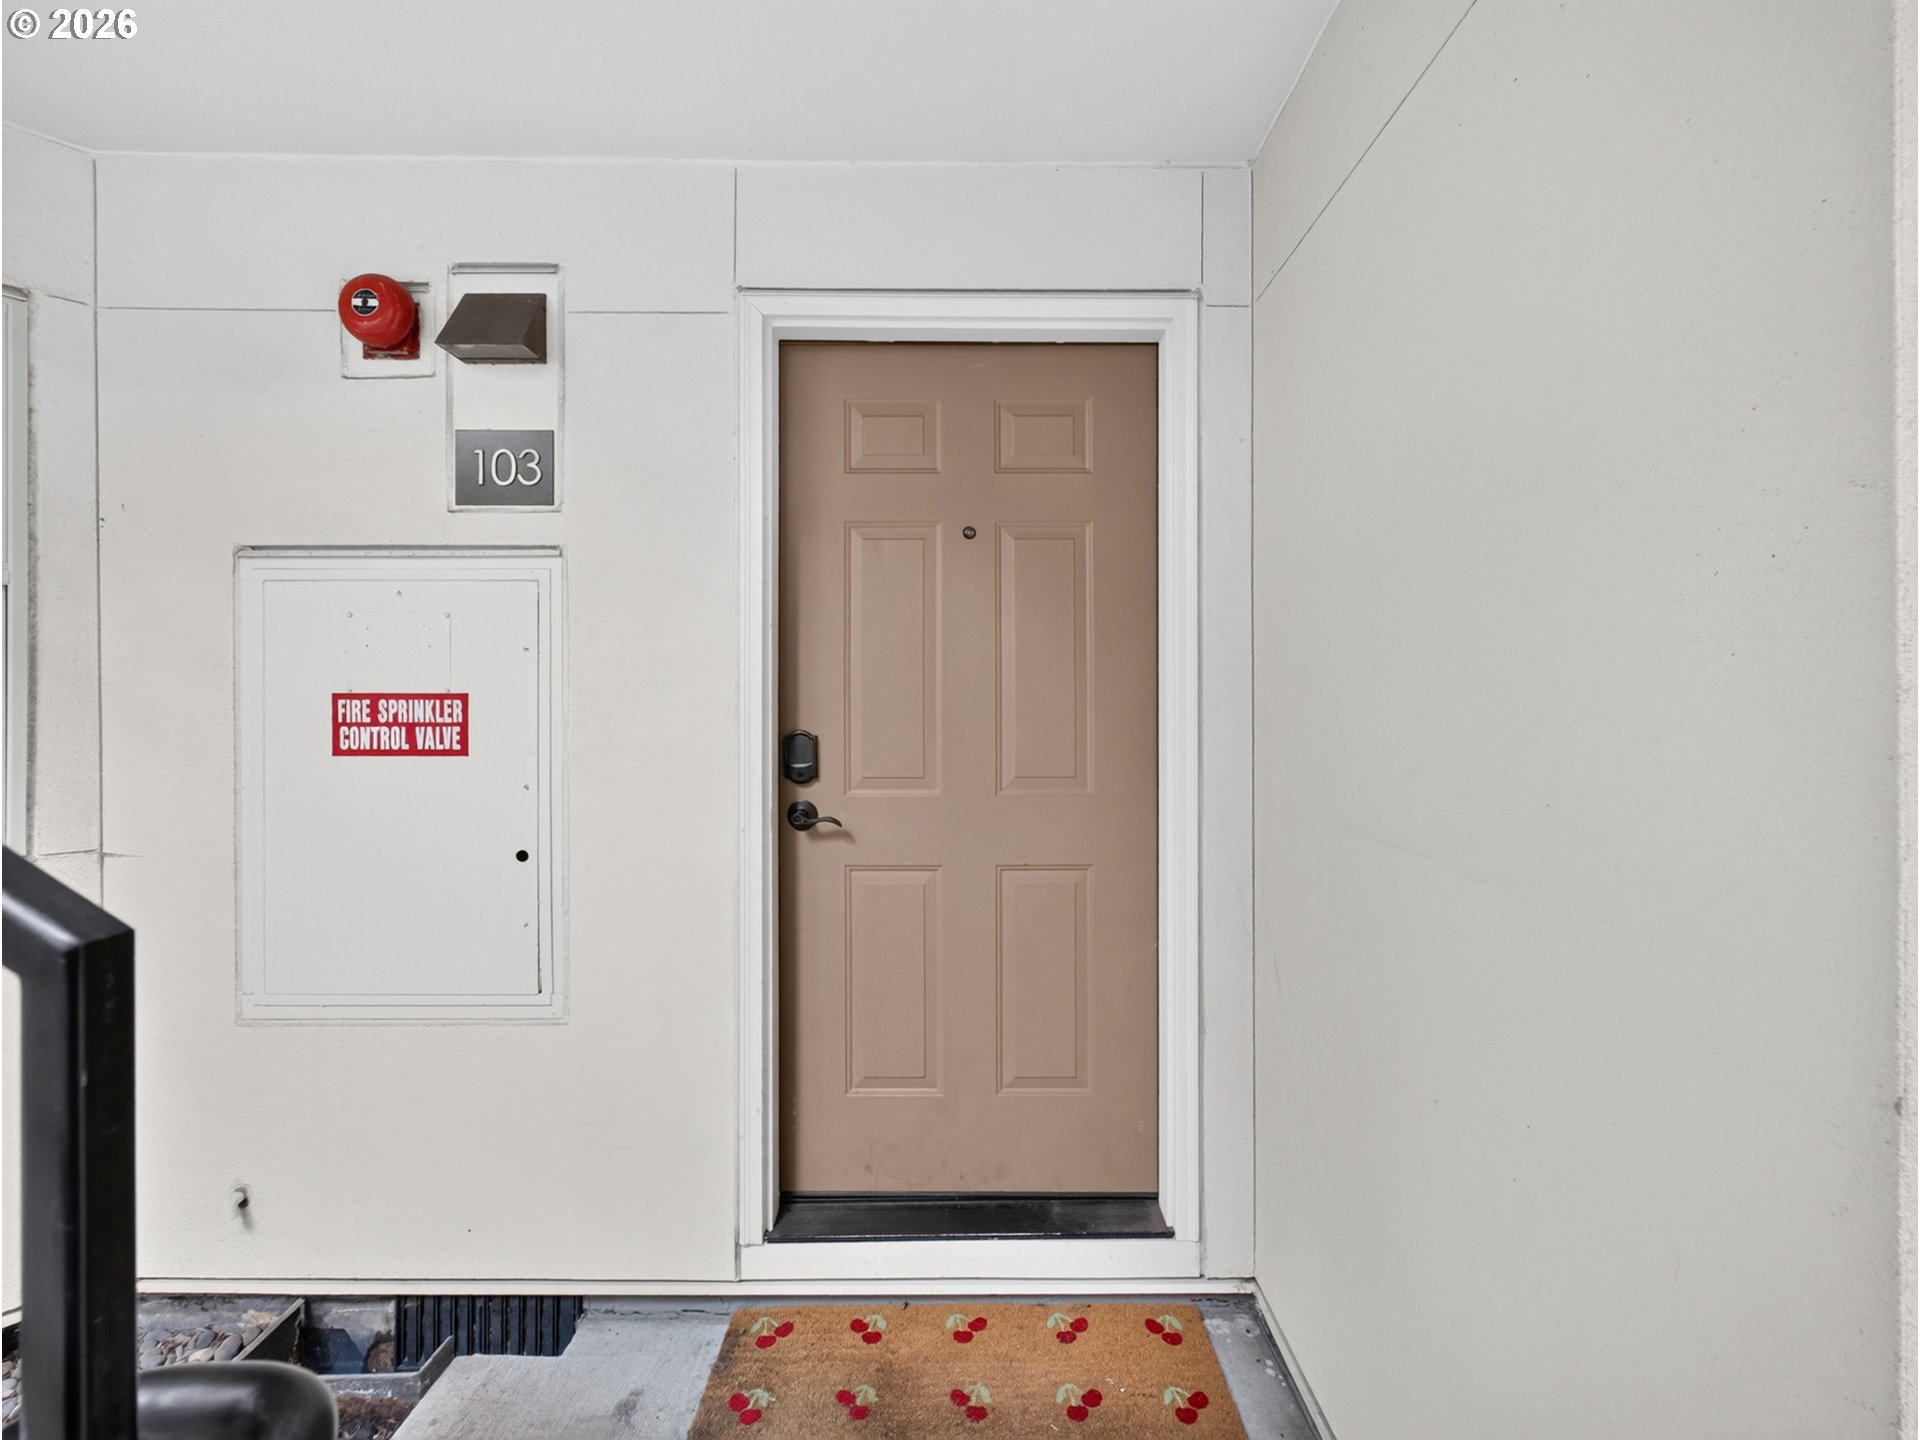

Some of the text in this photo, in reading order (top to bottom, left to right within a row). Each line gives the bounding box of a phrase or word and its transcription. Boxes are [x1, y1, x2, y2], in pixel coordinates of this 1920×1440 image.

[473, 448, 543, 487] 103
[337, 698, 463, 723] FIRE SPRINKLER
[339, 725, 462, 750] CONTROL VALVE
